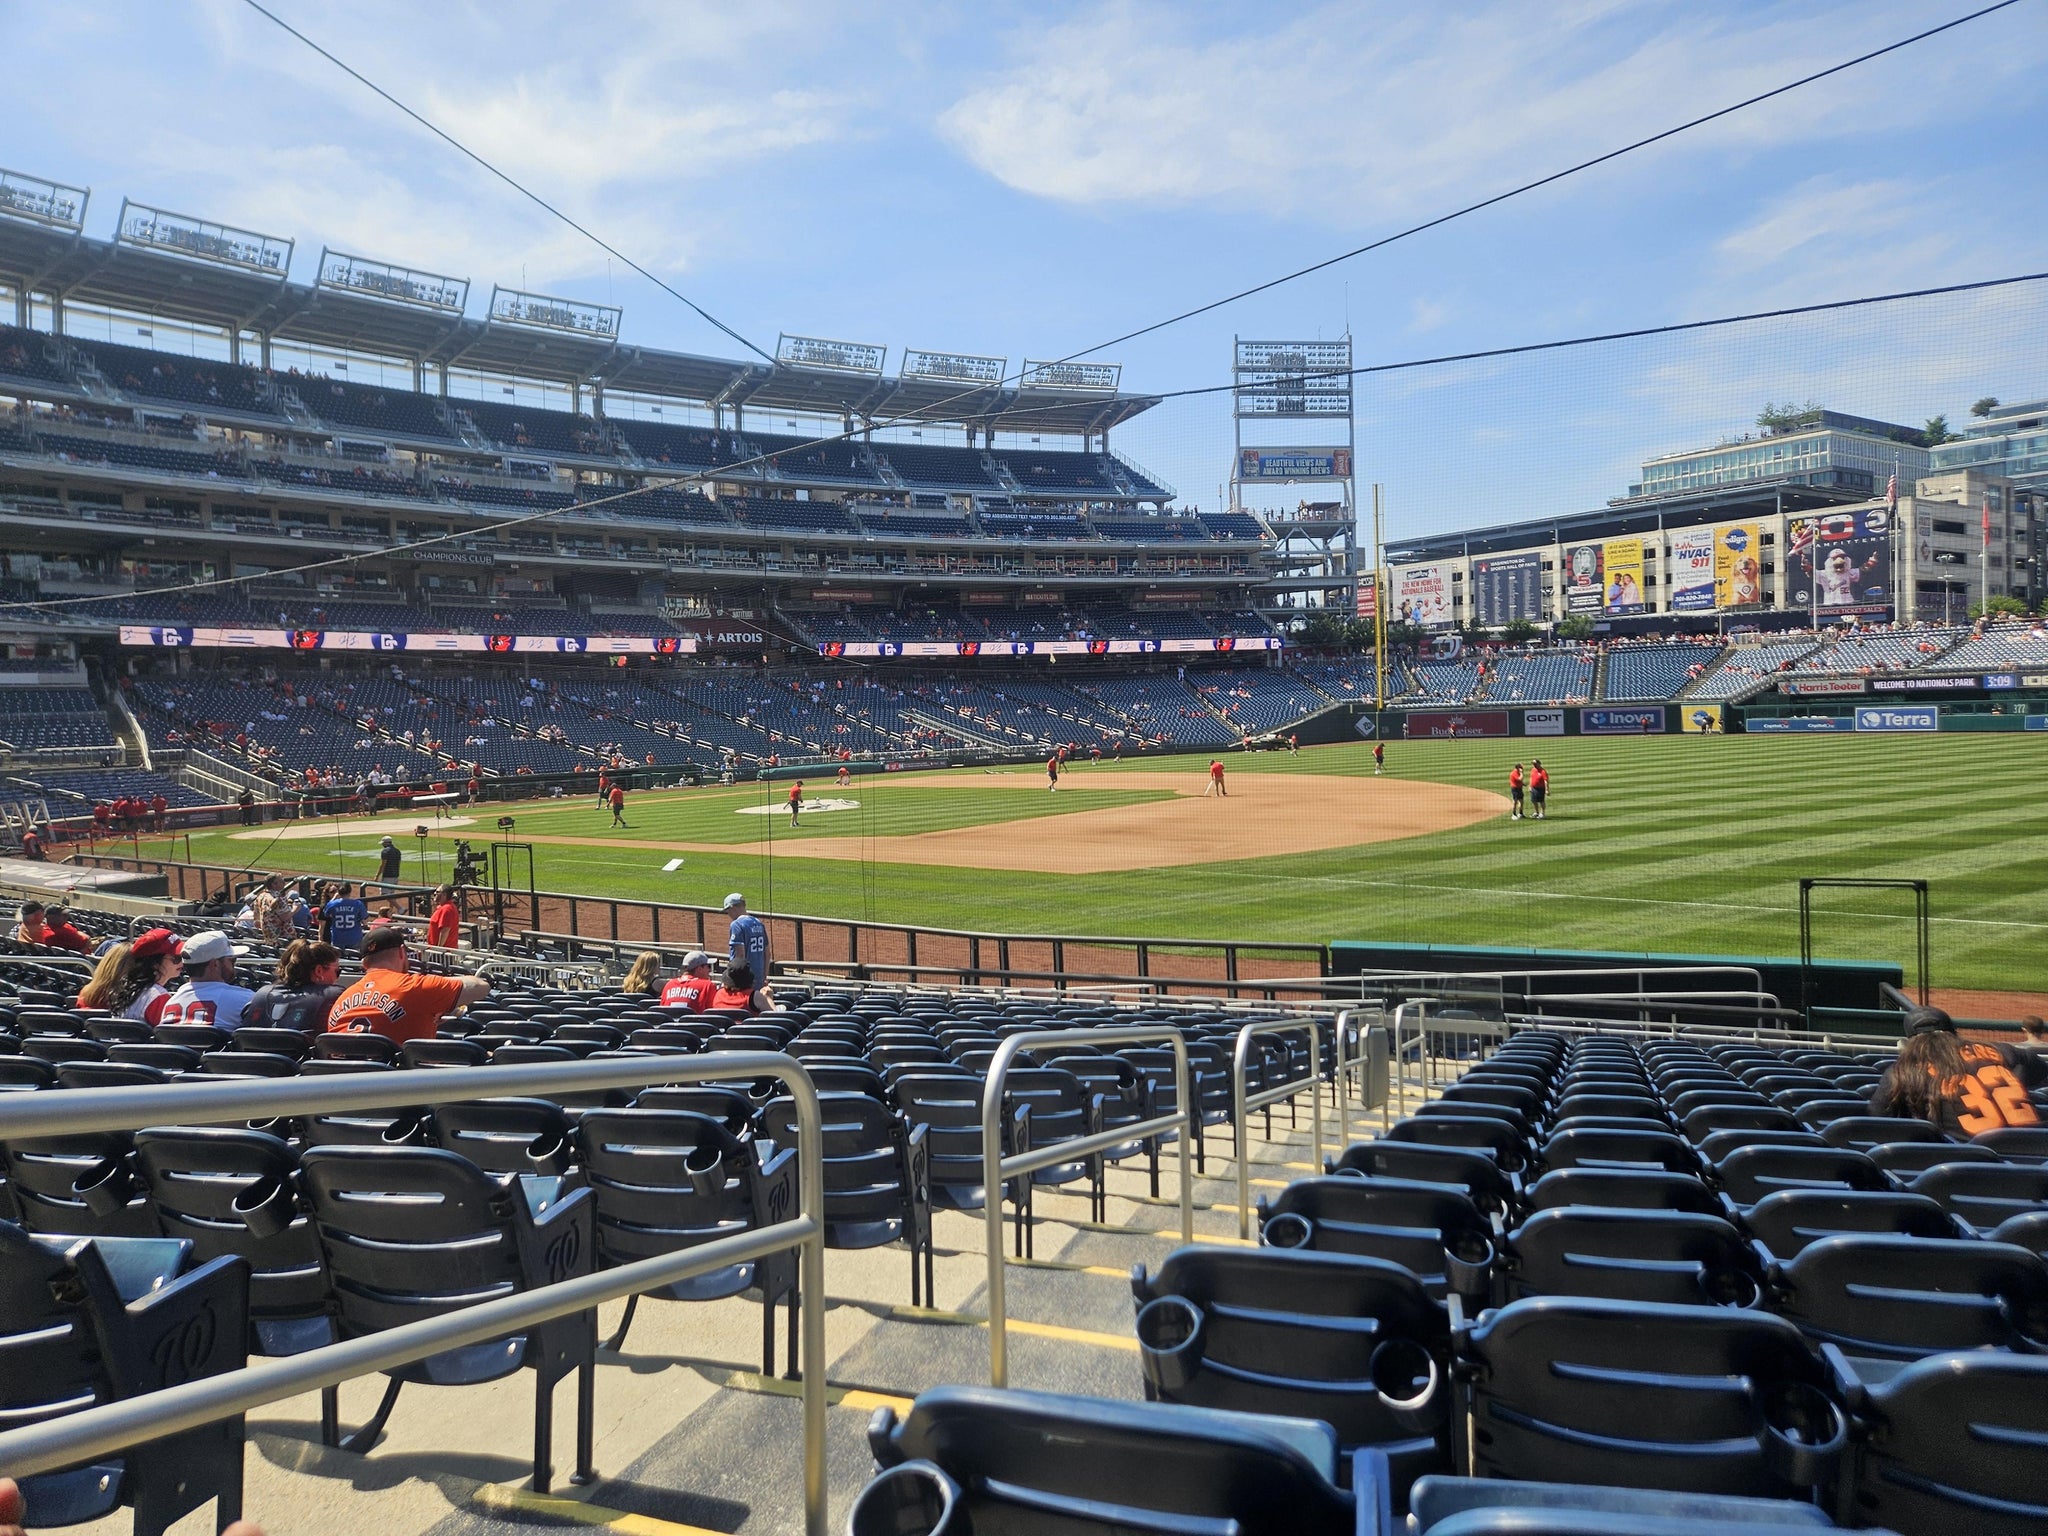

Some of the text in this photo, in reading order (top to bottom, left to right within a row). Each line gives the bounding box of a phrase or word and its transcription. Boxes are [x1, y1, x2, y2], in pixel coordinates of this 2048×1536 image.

[1296, 458, 1315, 467] VIEWS
[1315, 458, 1328, 466] AND
[1262, 467, 1284, 475] AWARD
[1284, 466, 1309, 475] WINNING
[413, 551, 468, 561] CHAMPIONS
[469, 555, 492, 564] CLUB
[1679, 547, 1712, 559] HVAC
[1691, 557, 1710, 568] 911
[1401, 584, 1444, 595] NATIONALS BASEBALL
[657, 606, 712, 618] Nationals
[1814, 605, 1882, 616] DVANCE TICKET SALES
[717, 633, 763, 643] ARTOIS
[1799, 682, 1862, 691] Harris Teeter
[1873, 678, 1976, 689] WELCOME TO NATIONALS PARK
[1987, 676, 2011, 687] 3:09
[2013, 704, 2026, 714] 377
[1526, 714, 1562, 723] GDIT
[1609, 712, 1655, 724] Inova
[1881, 712, 1931, 726] Terra
[1431, 726, 1483, 736] Budeiser
[335, 915, 355, 929] 25
[750, 936, 764, 953] 29
[666, 987, 699, 1000] ABRAMS
[329, 989, 406, 1029] HENDERSON
[1950, 1064, 2039, 1135] 32
